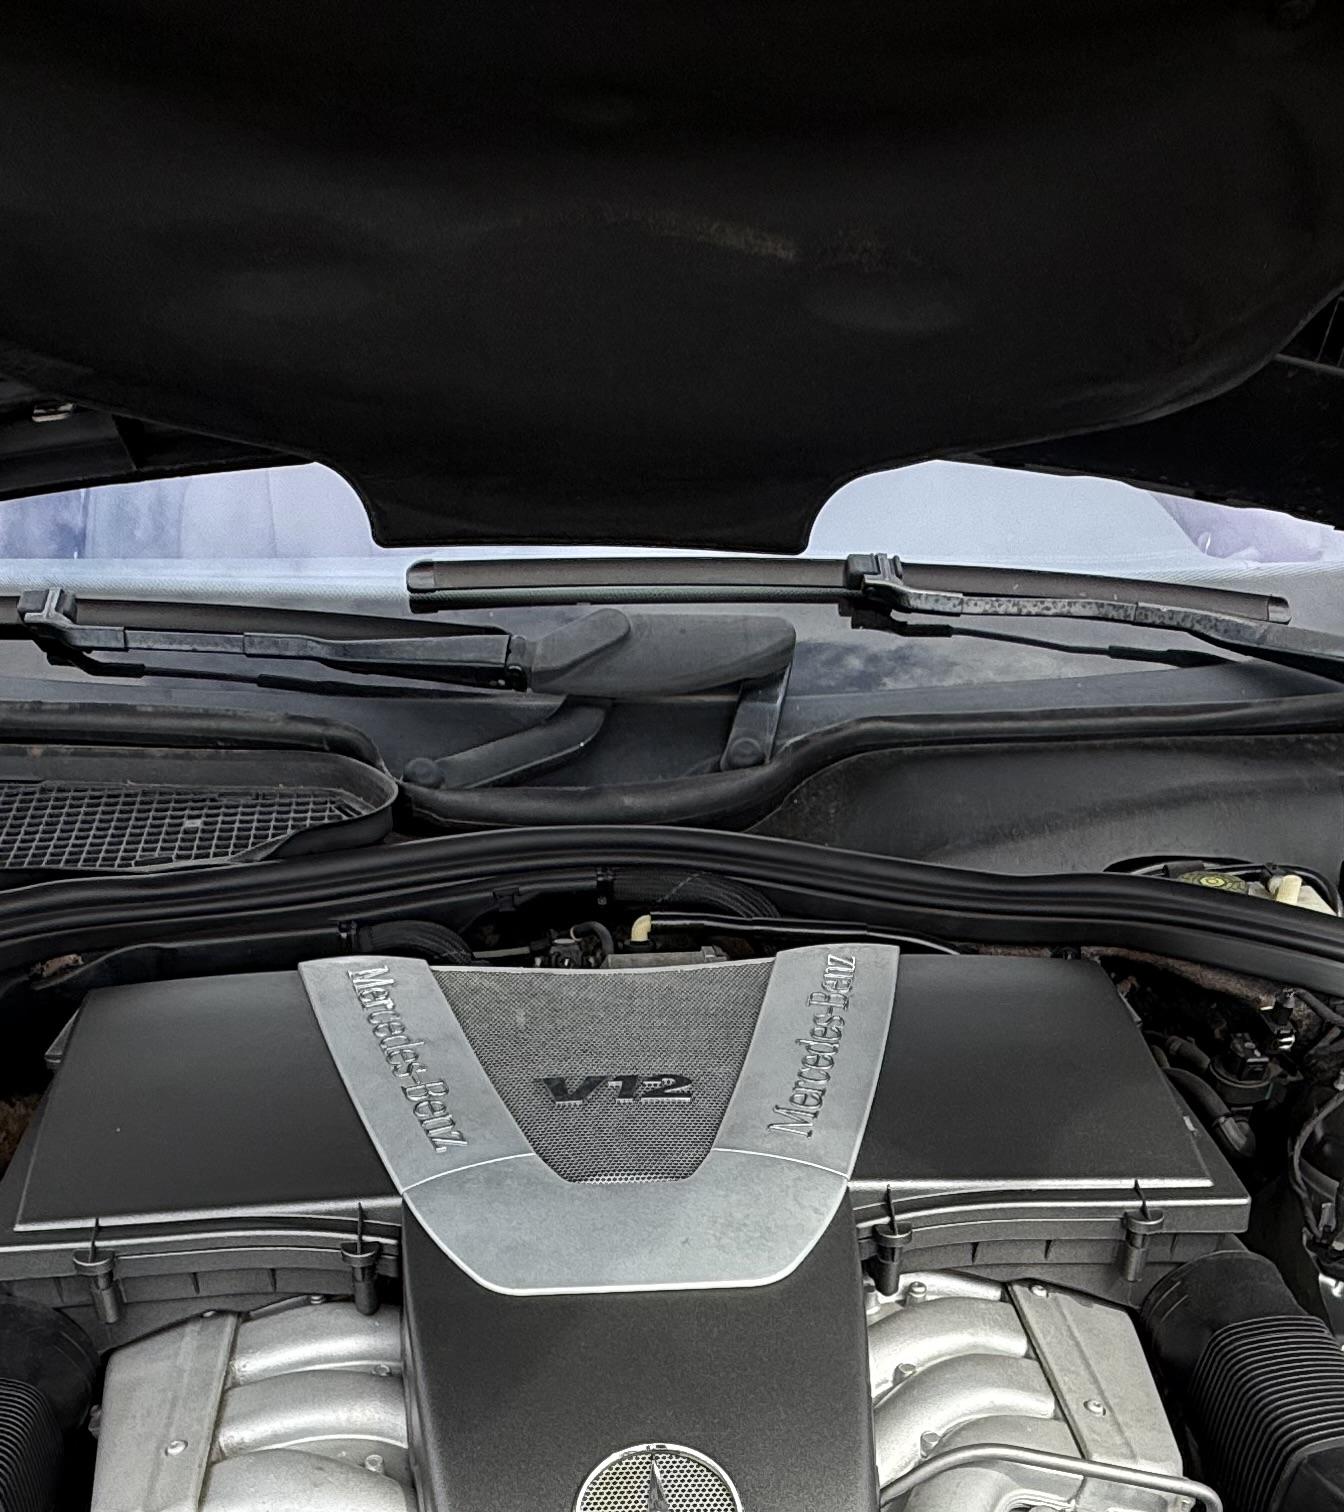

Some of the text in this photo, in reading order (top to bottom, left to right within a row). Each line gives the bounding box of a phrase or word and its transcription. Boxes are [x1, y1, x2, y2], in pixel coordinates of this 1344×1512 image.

[348, 964, 468, 1153] Mercedes-Benz
[536, 1073, 693, 1103] V12
[767, 953, 856, 1140] Mercedes-Benz
